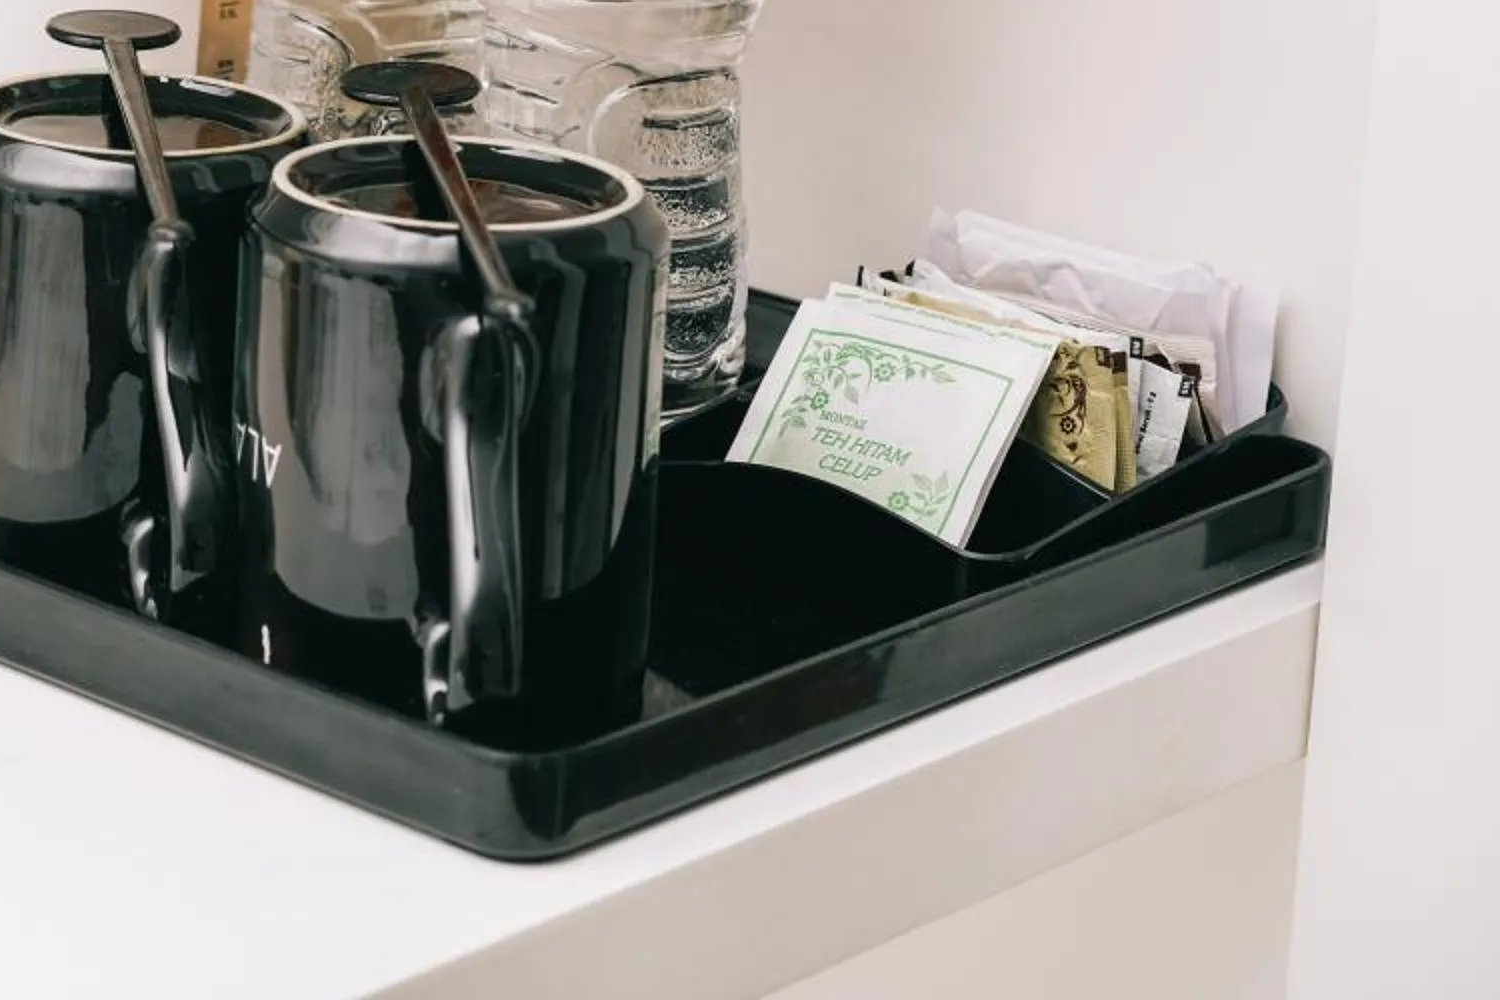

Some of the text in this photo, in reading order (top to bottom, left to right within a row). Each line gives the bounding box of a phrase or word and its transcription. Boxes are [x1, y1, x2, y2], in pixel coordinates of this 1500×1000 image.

[811, 426, 913, 466] TEH HITAM
[819, 453, 883, 480] CELUP
